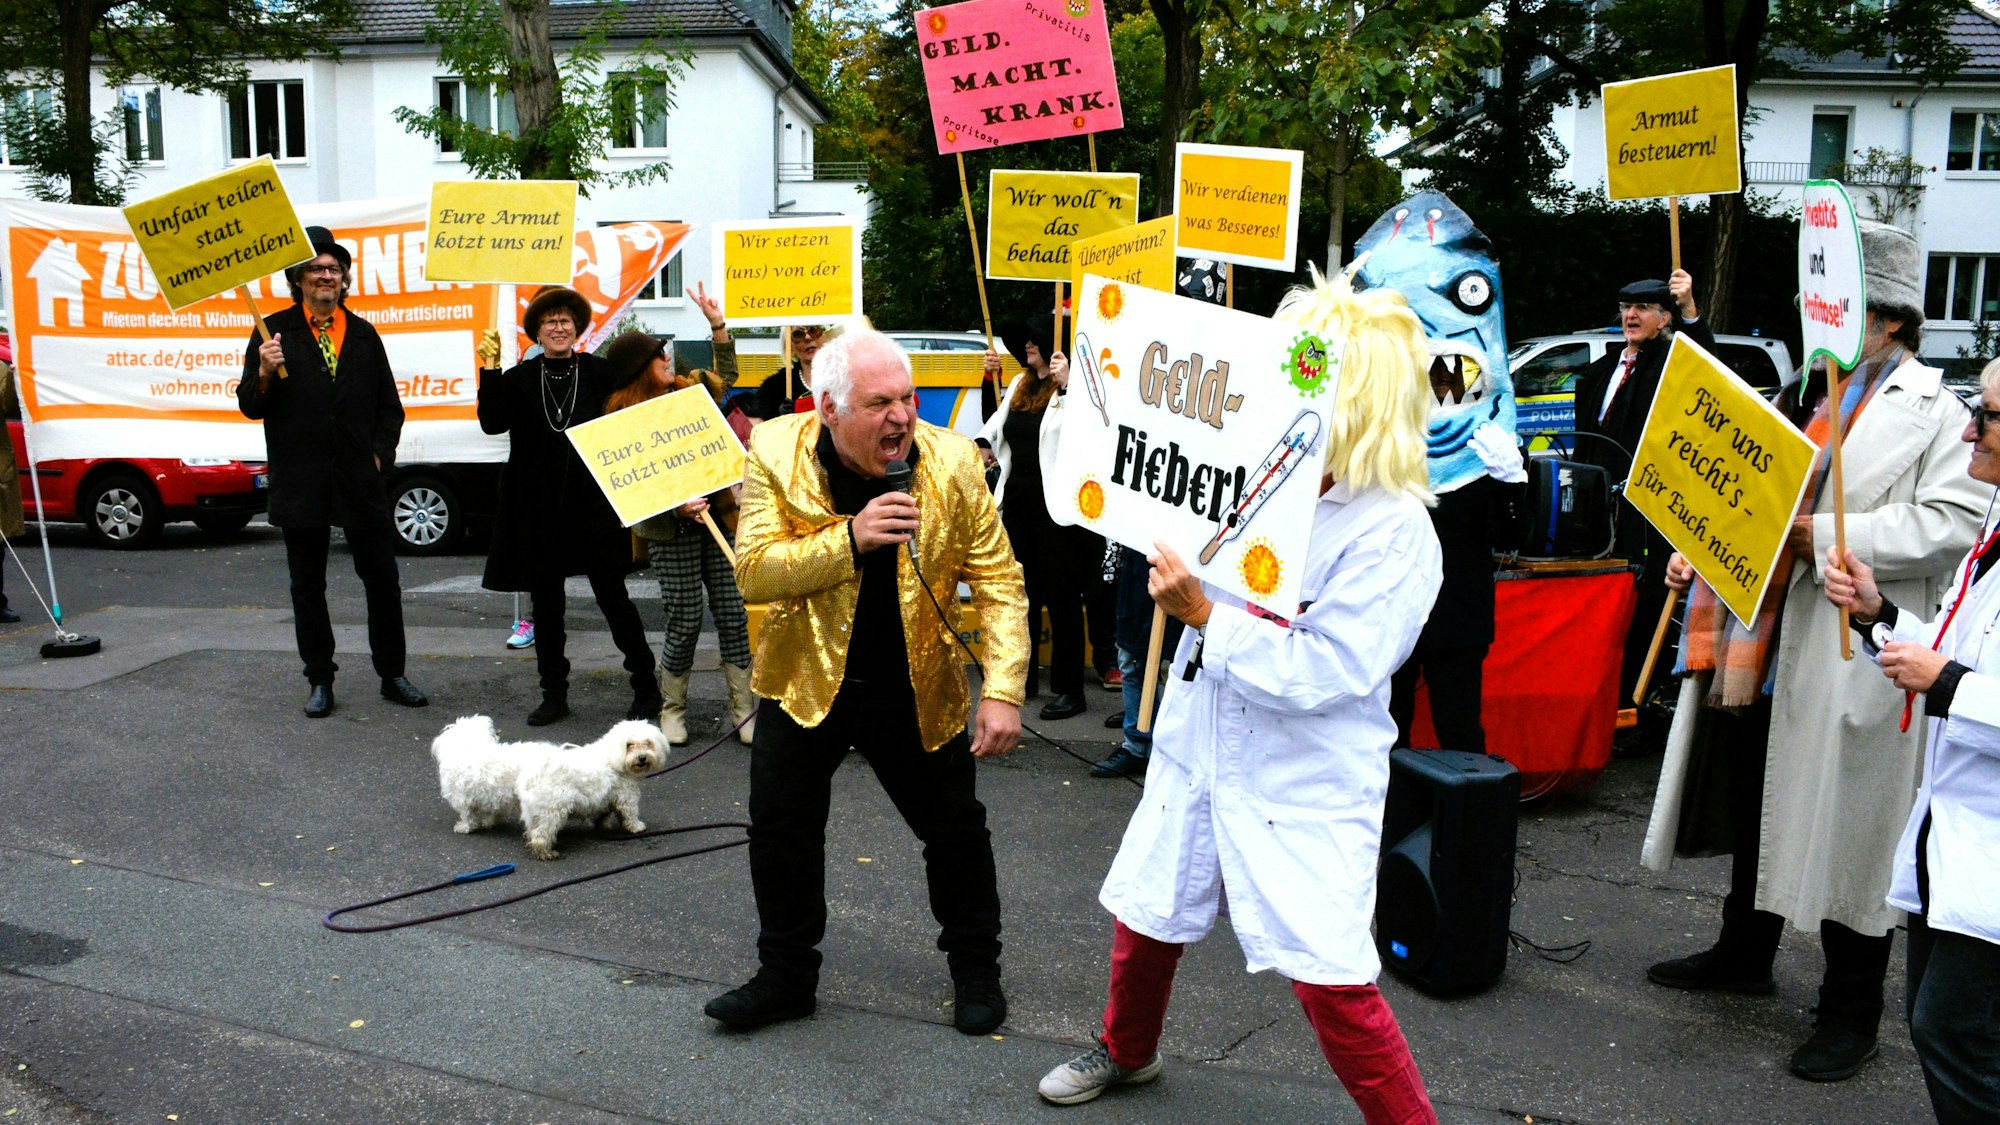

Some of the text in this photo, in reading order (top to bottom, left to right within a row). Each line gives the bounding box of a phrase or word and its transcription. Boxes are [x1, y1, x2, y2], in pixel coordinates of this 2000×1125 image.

[924, 31, 1010, 60] GELD.
[951, 57, 1082, 94] MACHT.
[981, 91, 1114, 126] KRANK.
[1631, 104, 1700, 132] Armut
[1618, 135, 1717, 165] besteuern!
[1005, 186, 1047, 208] Wir
[1181, 178, 1288, 207] Wir verdienen
[140, 176, 276, 239] Unfair teilen
[439, 208, 561, 227] Eure Armut
[196, 219, 243, 249] statt
[434, 231, 563, 251] kotzt uns an!
[736, 232, 829, 249] Wir setzen
[1044, 216, 1080, 237] das
[1184, 216, 1281, 239] was Besseres!
[167, 228, 296, 289] umverteilen!
[1006, 242, 1073, 265] behalt
[1078, 228, 1167, 267] Übergewinn?
[1809, 246, 1825, 276] und
[726, 259, 841, 280] (uns) von der
[740, 292, 827, 310] Steuer ab!
[102, 311, 146, 328] Mieten
[148, 311, 204, 329] deckeln,
[150, 378, 241, 399] wohnen@
[396, 374, 463, 398] attac
[597, 414, 711, 468] Eure Armut
[1685, 387, 1774, 474] Für uns
[610, 436, 728, 492] kotzt uns an!
[1634, 463, 1760, 593] für Euch nicht!
